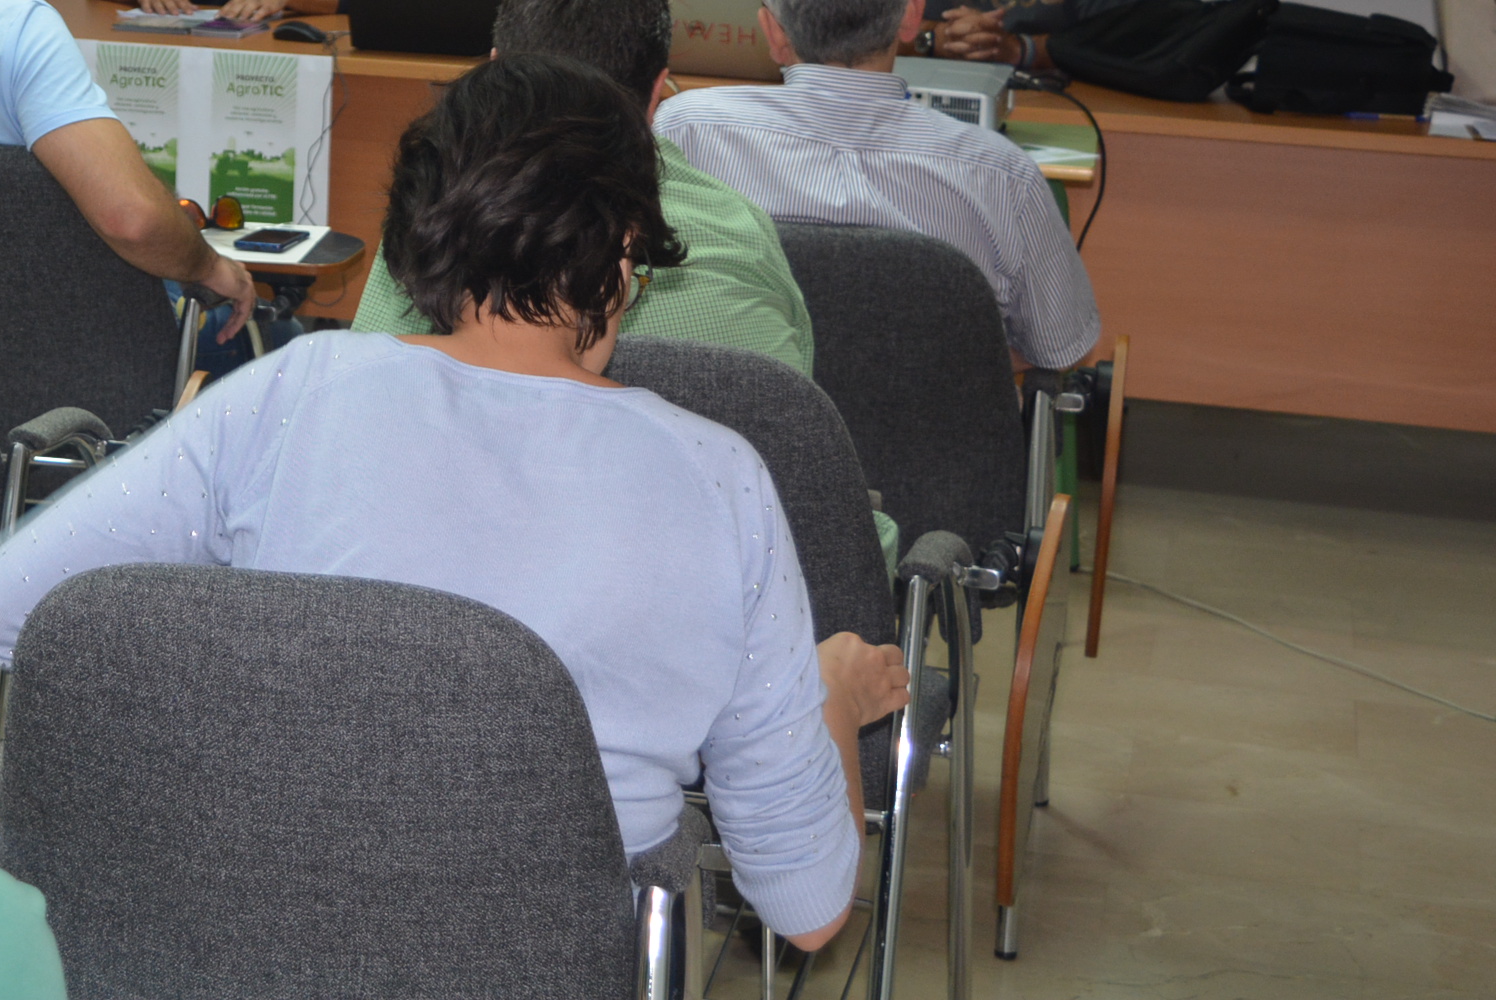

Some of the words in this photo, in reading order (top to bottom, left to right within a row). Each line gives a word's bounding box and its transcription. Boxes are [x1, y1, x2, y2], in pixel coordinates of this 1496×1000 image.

[118, 65, 157, 75] PROYECTO
[109, 73, 166, 89] AgroTIC
[236, 74, 275, 84] PROYECTO
[225, 82, 285, 98] AgroTIC
